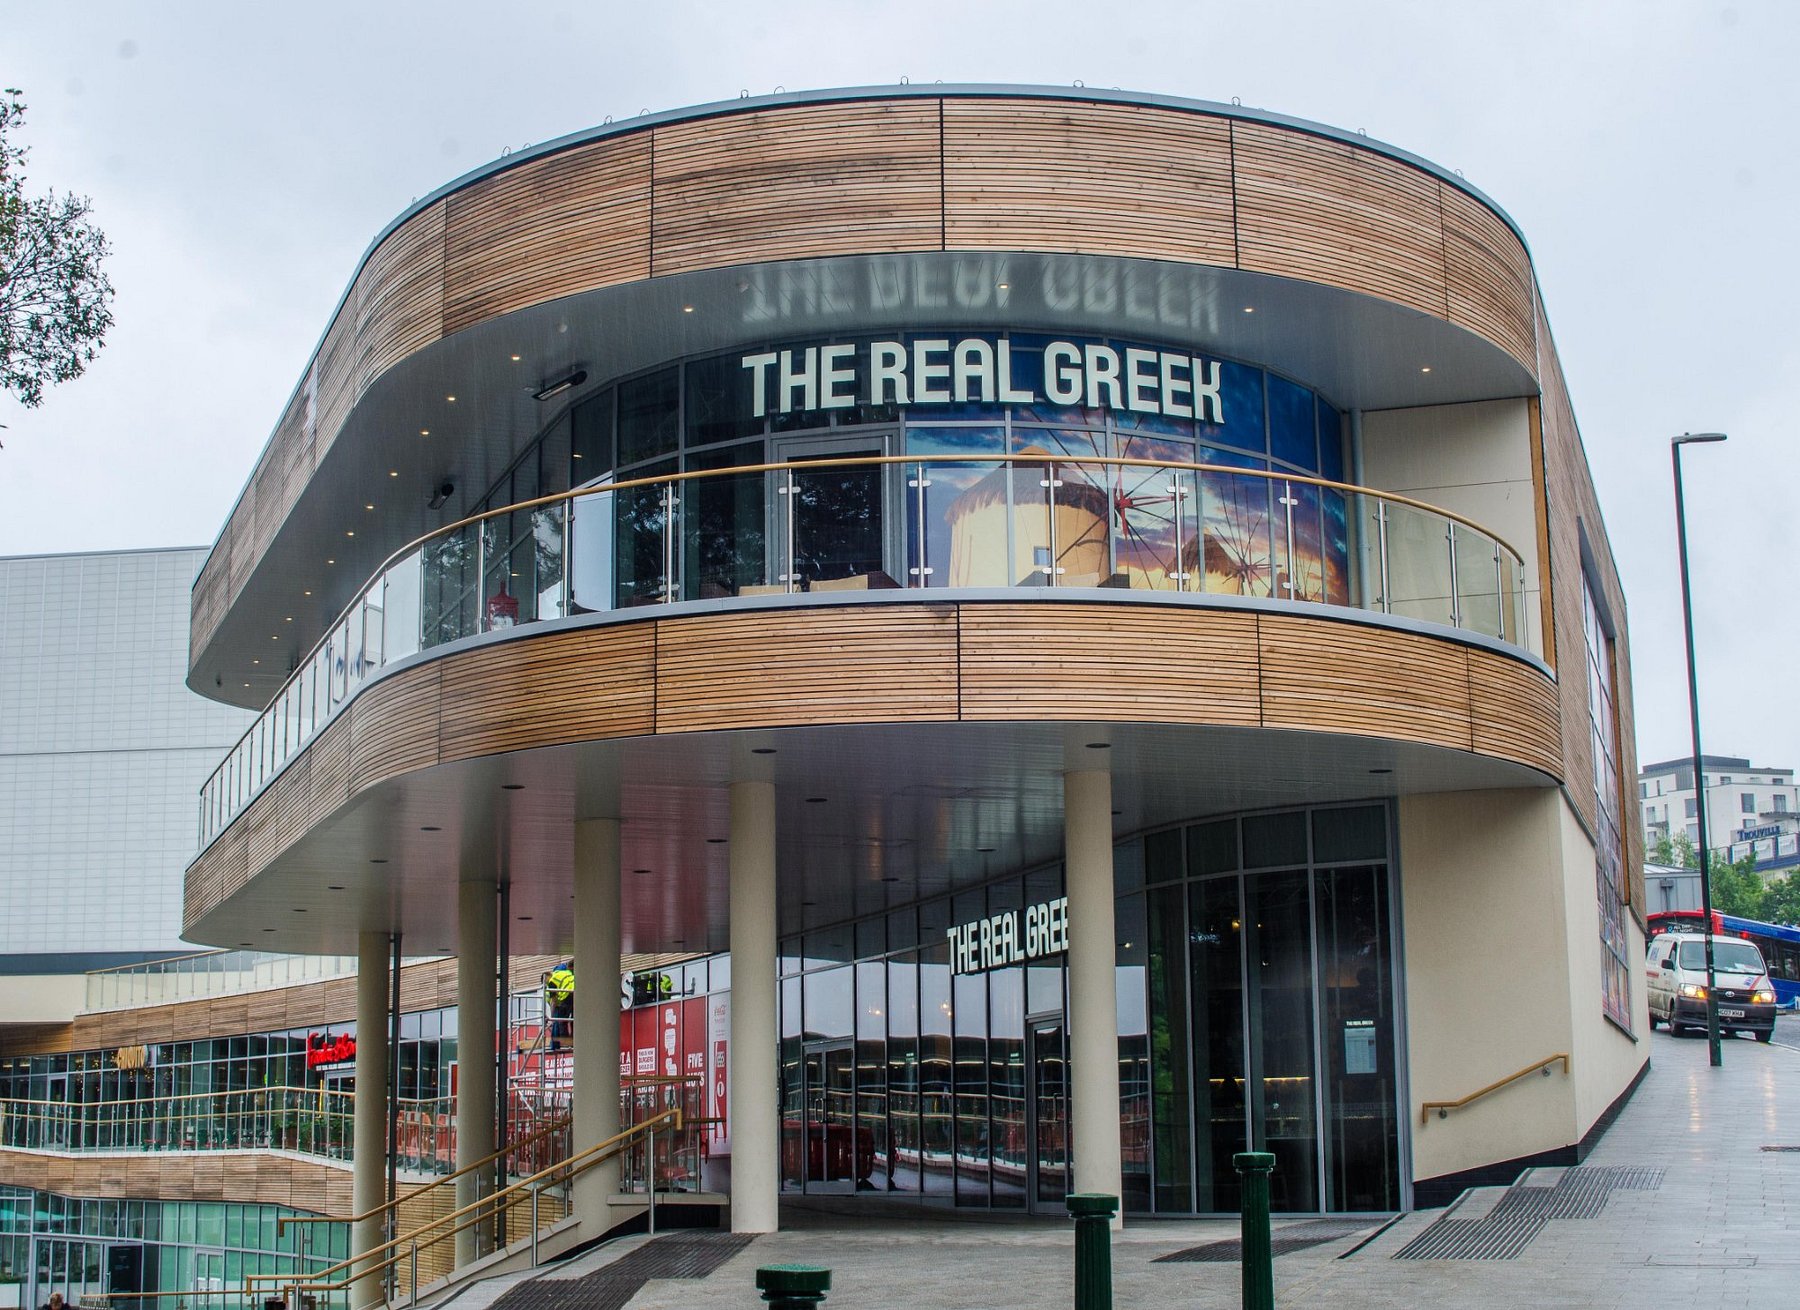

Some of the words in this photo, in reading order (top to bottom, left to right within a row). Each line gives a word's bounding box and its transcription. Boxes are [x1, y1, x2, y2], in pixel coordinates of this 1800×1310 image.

[741, 344, 856, 417] THE
[870, 338, 1034, 405] REAL
[1044, 341, 1225, 424] GREEK
[947, 921, 979, 975] THE
[980, 911, 1025, 969] REAL
[1026, 897, 1069, 957] GREE
[688, 1053, 703, 1068] FIVE
